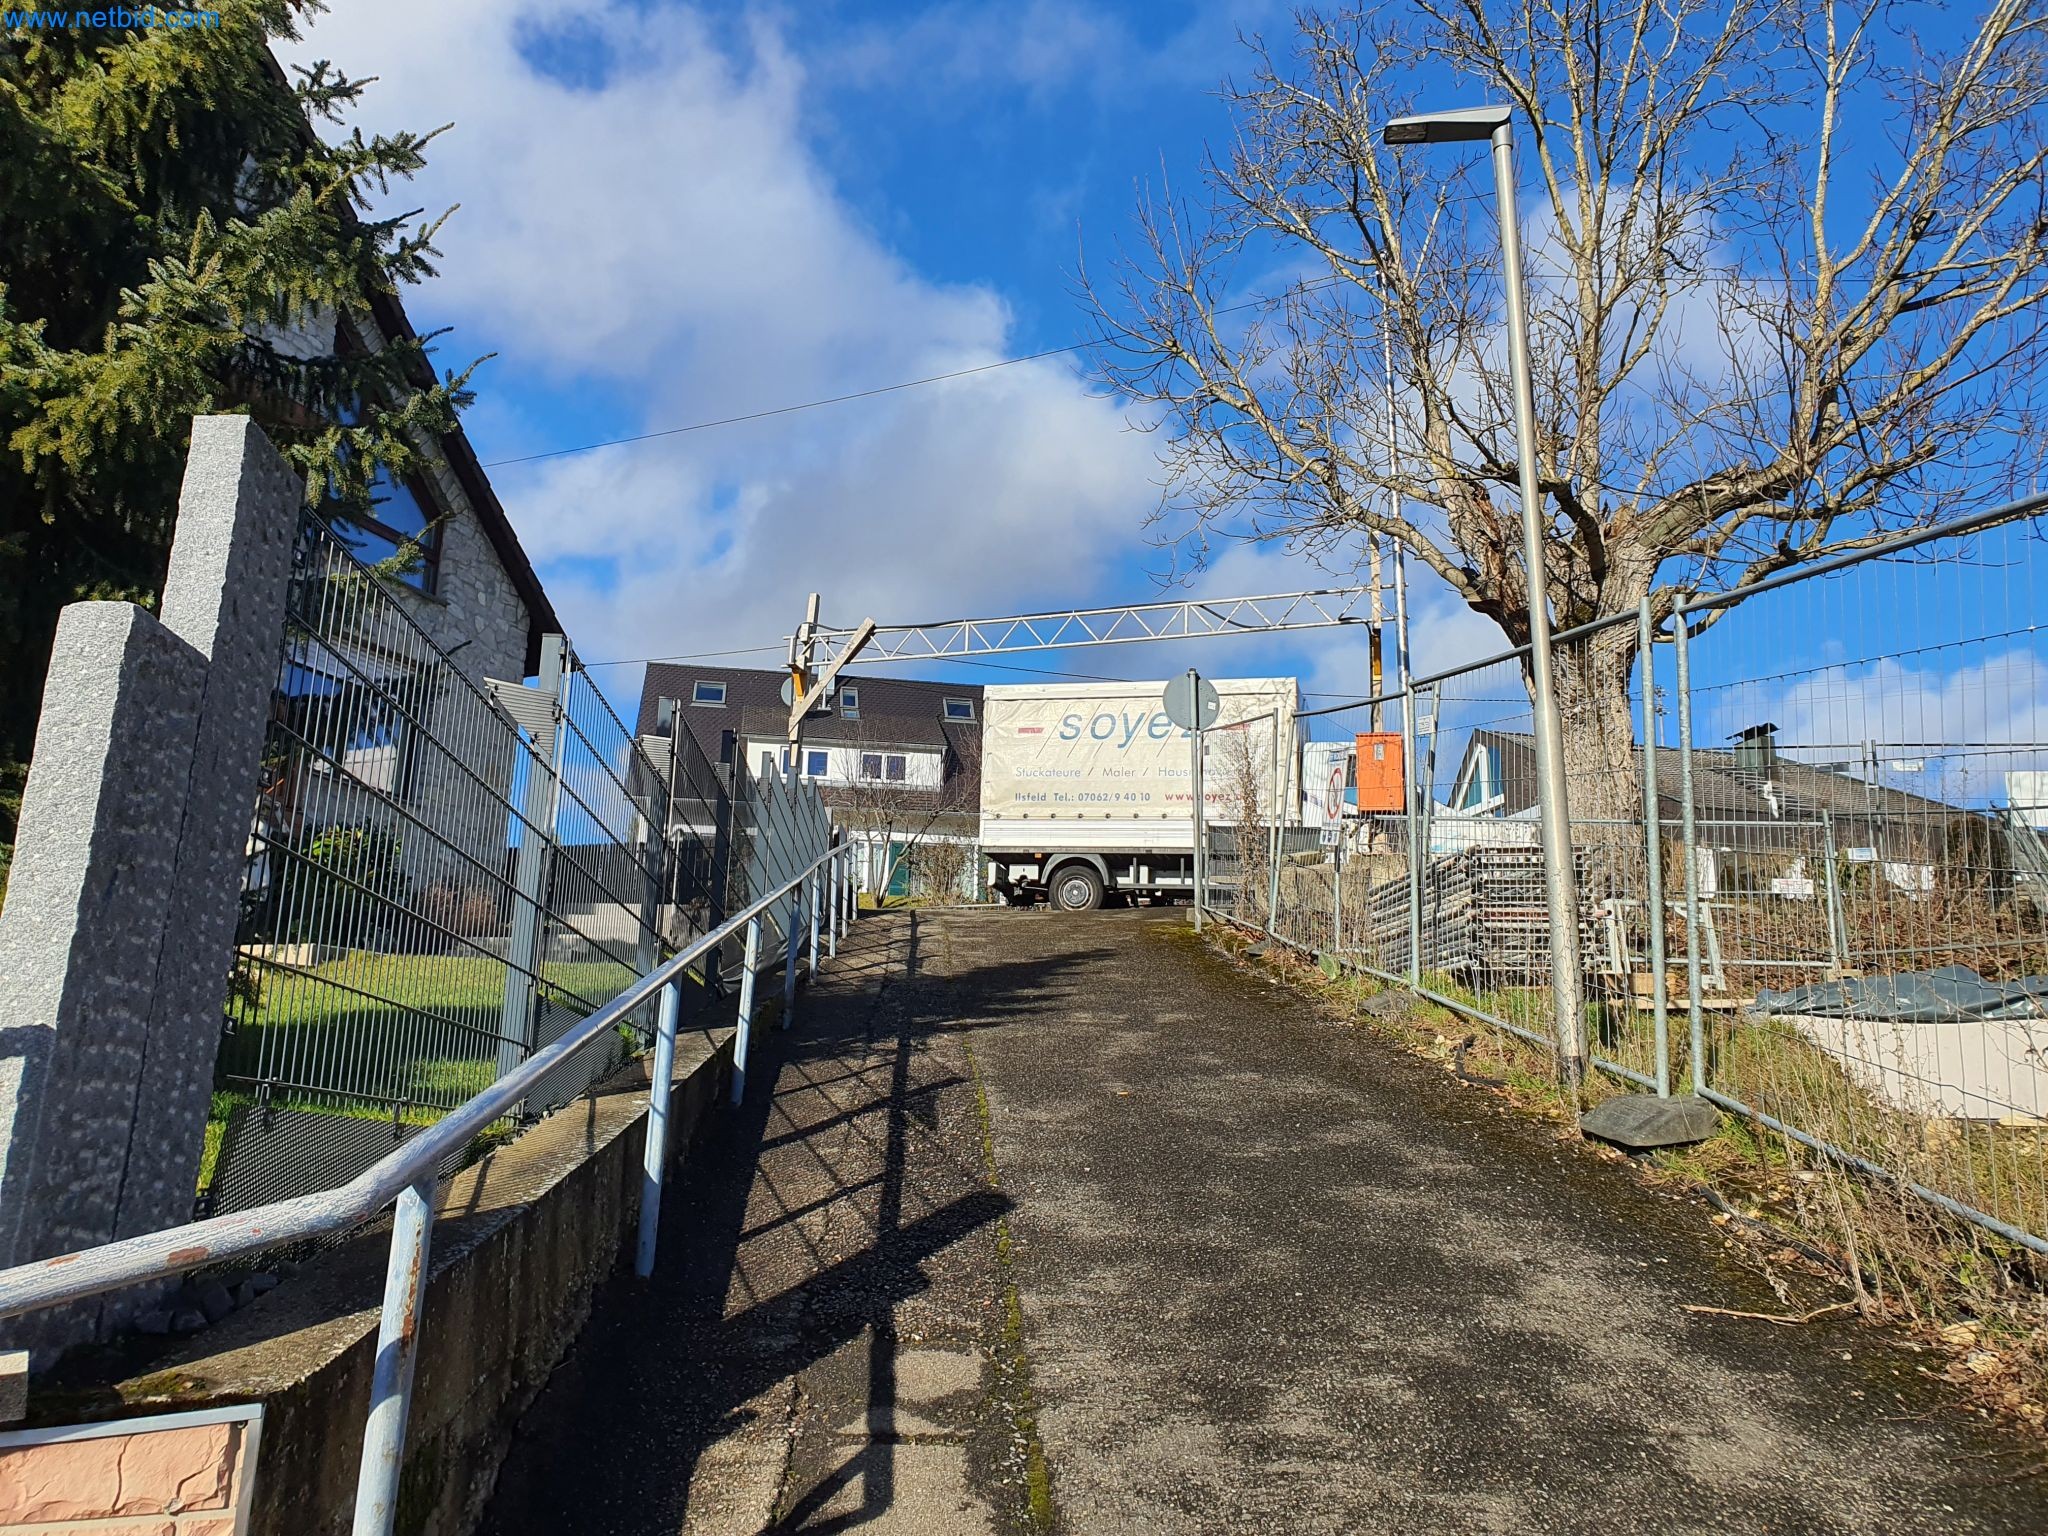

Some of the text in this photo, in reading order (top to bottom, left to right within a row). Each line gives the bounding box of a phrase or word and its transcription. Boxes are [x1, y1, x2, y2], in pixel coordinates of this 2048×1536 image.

[1015, 766, 1081, 777] Stuckateure
[1102, 766, 1135, 777] Maler
[1053, 792, 1074, 802] Tel.:
